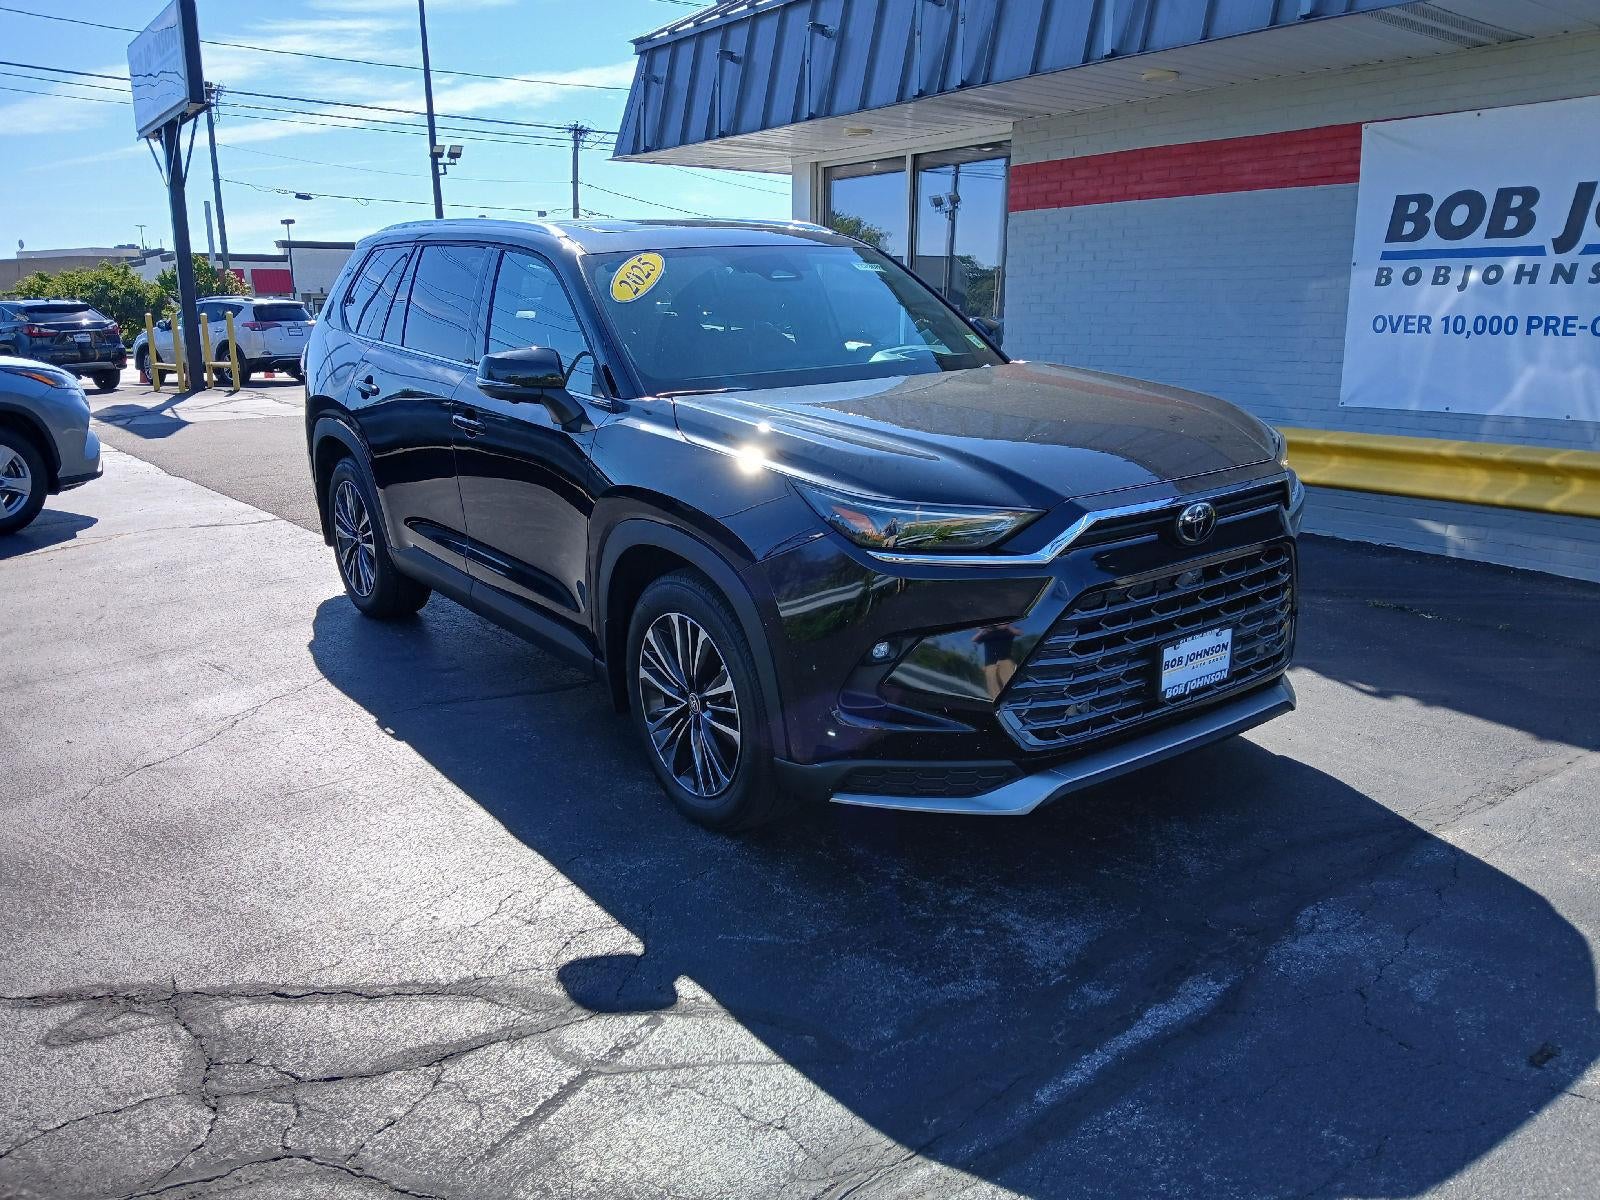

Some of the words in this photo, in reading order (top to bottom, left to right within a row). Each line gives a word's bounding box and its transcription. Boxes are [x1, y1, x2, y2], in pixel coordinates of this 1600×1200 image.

[1384, 185, 1541, 244] BOB
[1551, 180, 1600, 255] J
[618, 256, 656, 296] 2025
[1372, 314, 1432, 335] OVER
[1440, 315, 1519, 339] 10,000
[1163, 656, 1184, 671] BOB
[1185, 641, 1229, 667] JOHNSON
[1192, 661, 1206, 670] AUTO
[1165, 683, 1185, 699] BOB
[1185, 669, 1229, 695] JOHNSON
